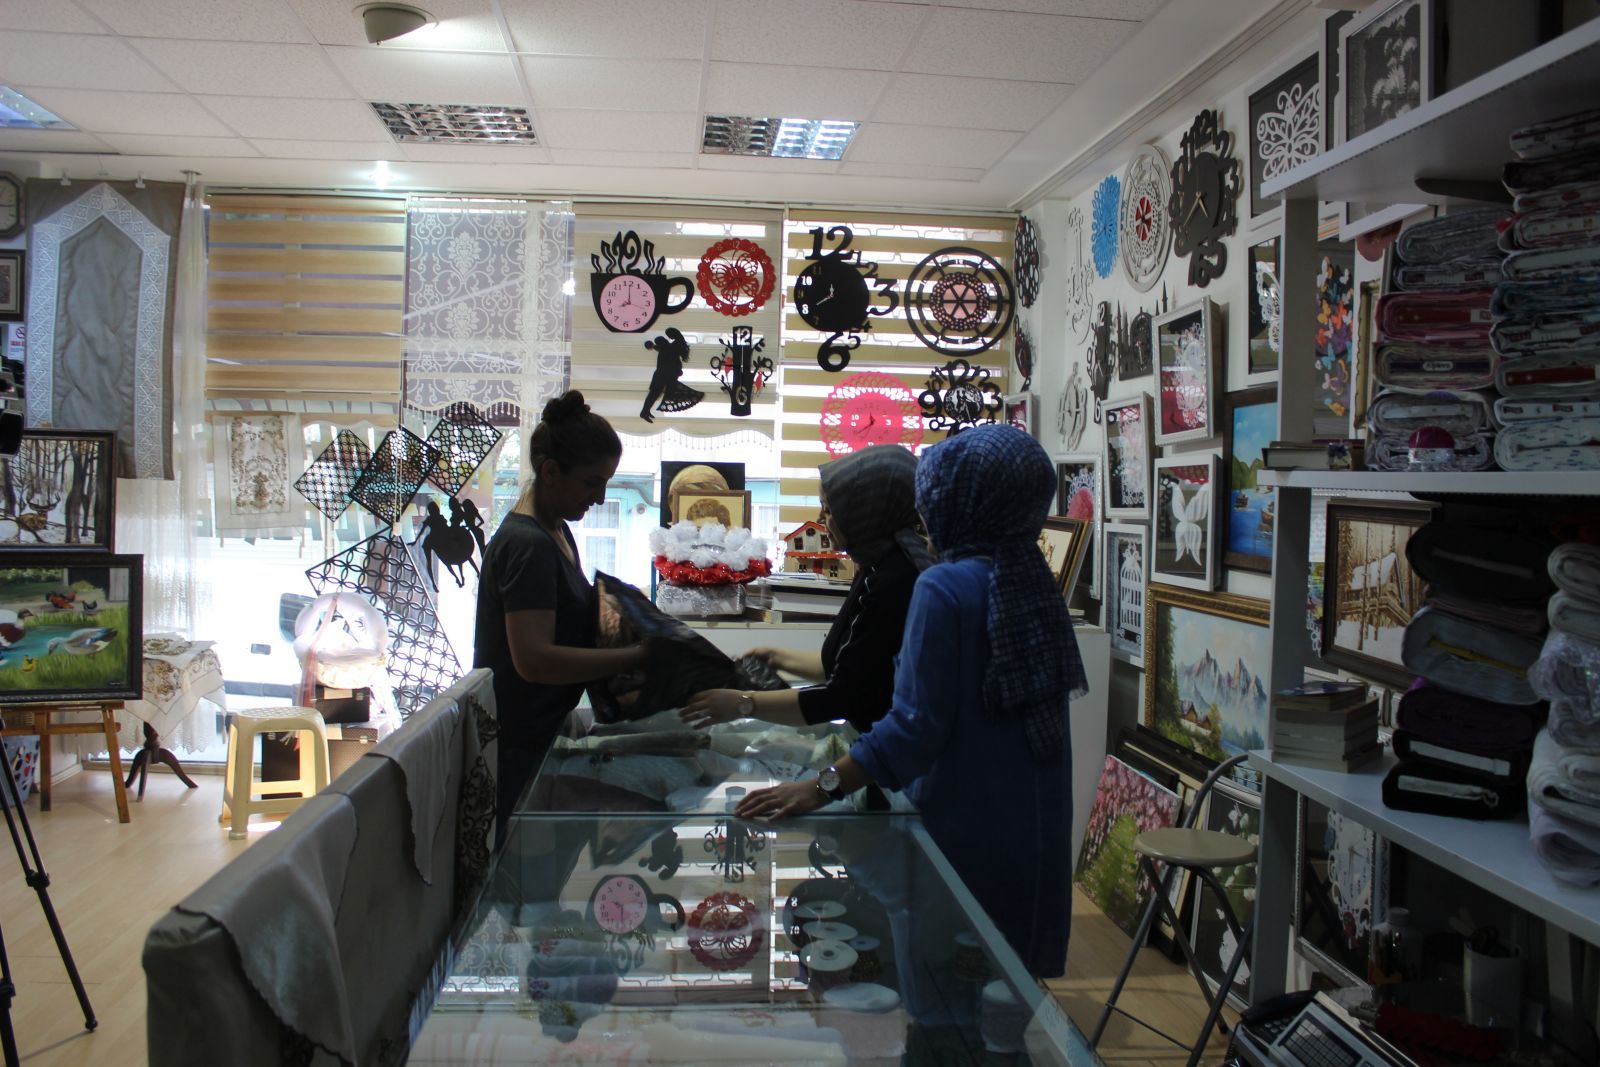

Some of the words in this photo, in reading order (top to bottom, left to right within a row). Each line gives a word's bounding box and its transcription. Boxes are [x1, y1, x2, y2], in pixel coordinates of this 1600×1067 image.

[611, 230, 642, 275] 12
[804, 225, 854, 260] 12
[801, 275, 813, 286] 10
[866, 261, 879, 278] 2
[623, 280, 635, 288] 12
[641, 290, 648, 298] 2
[866, 278, 900, 316] 3
[613, 315, 620, 323] 7
[801, 303, 809, 315] 8
[734, 327, 751, 346] 12
[816, 330, 851, 373] 6
[736, 384, 748, 406] 6
[917, 390, 944, 418] 9
[982, 381, 1004, 412] 3
[1094, 396, 1101, 420] 6
